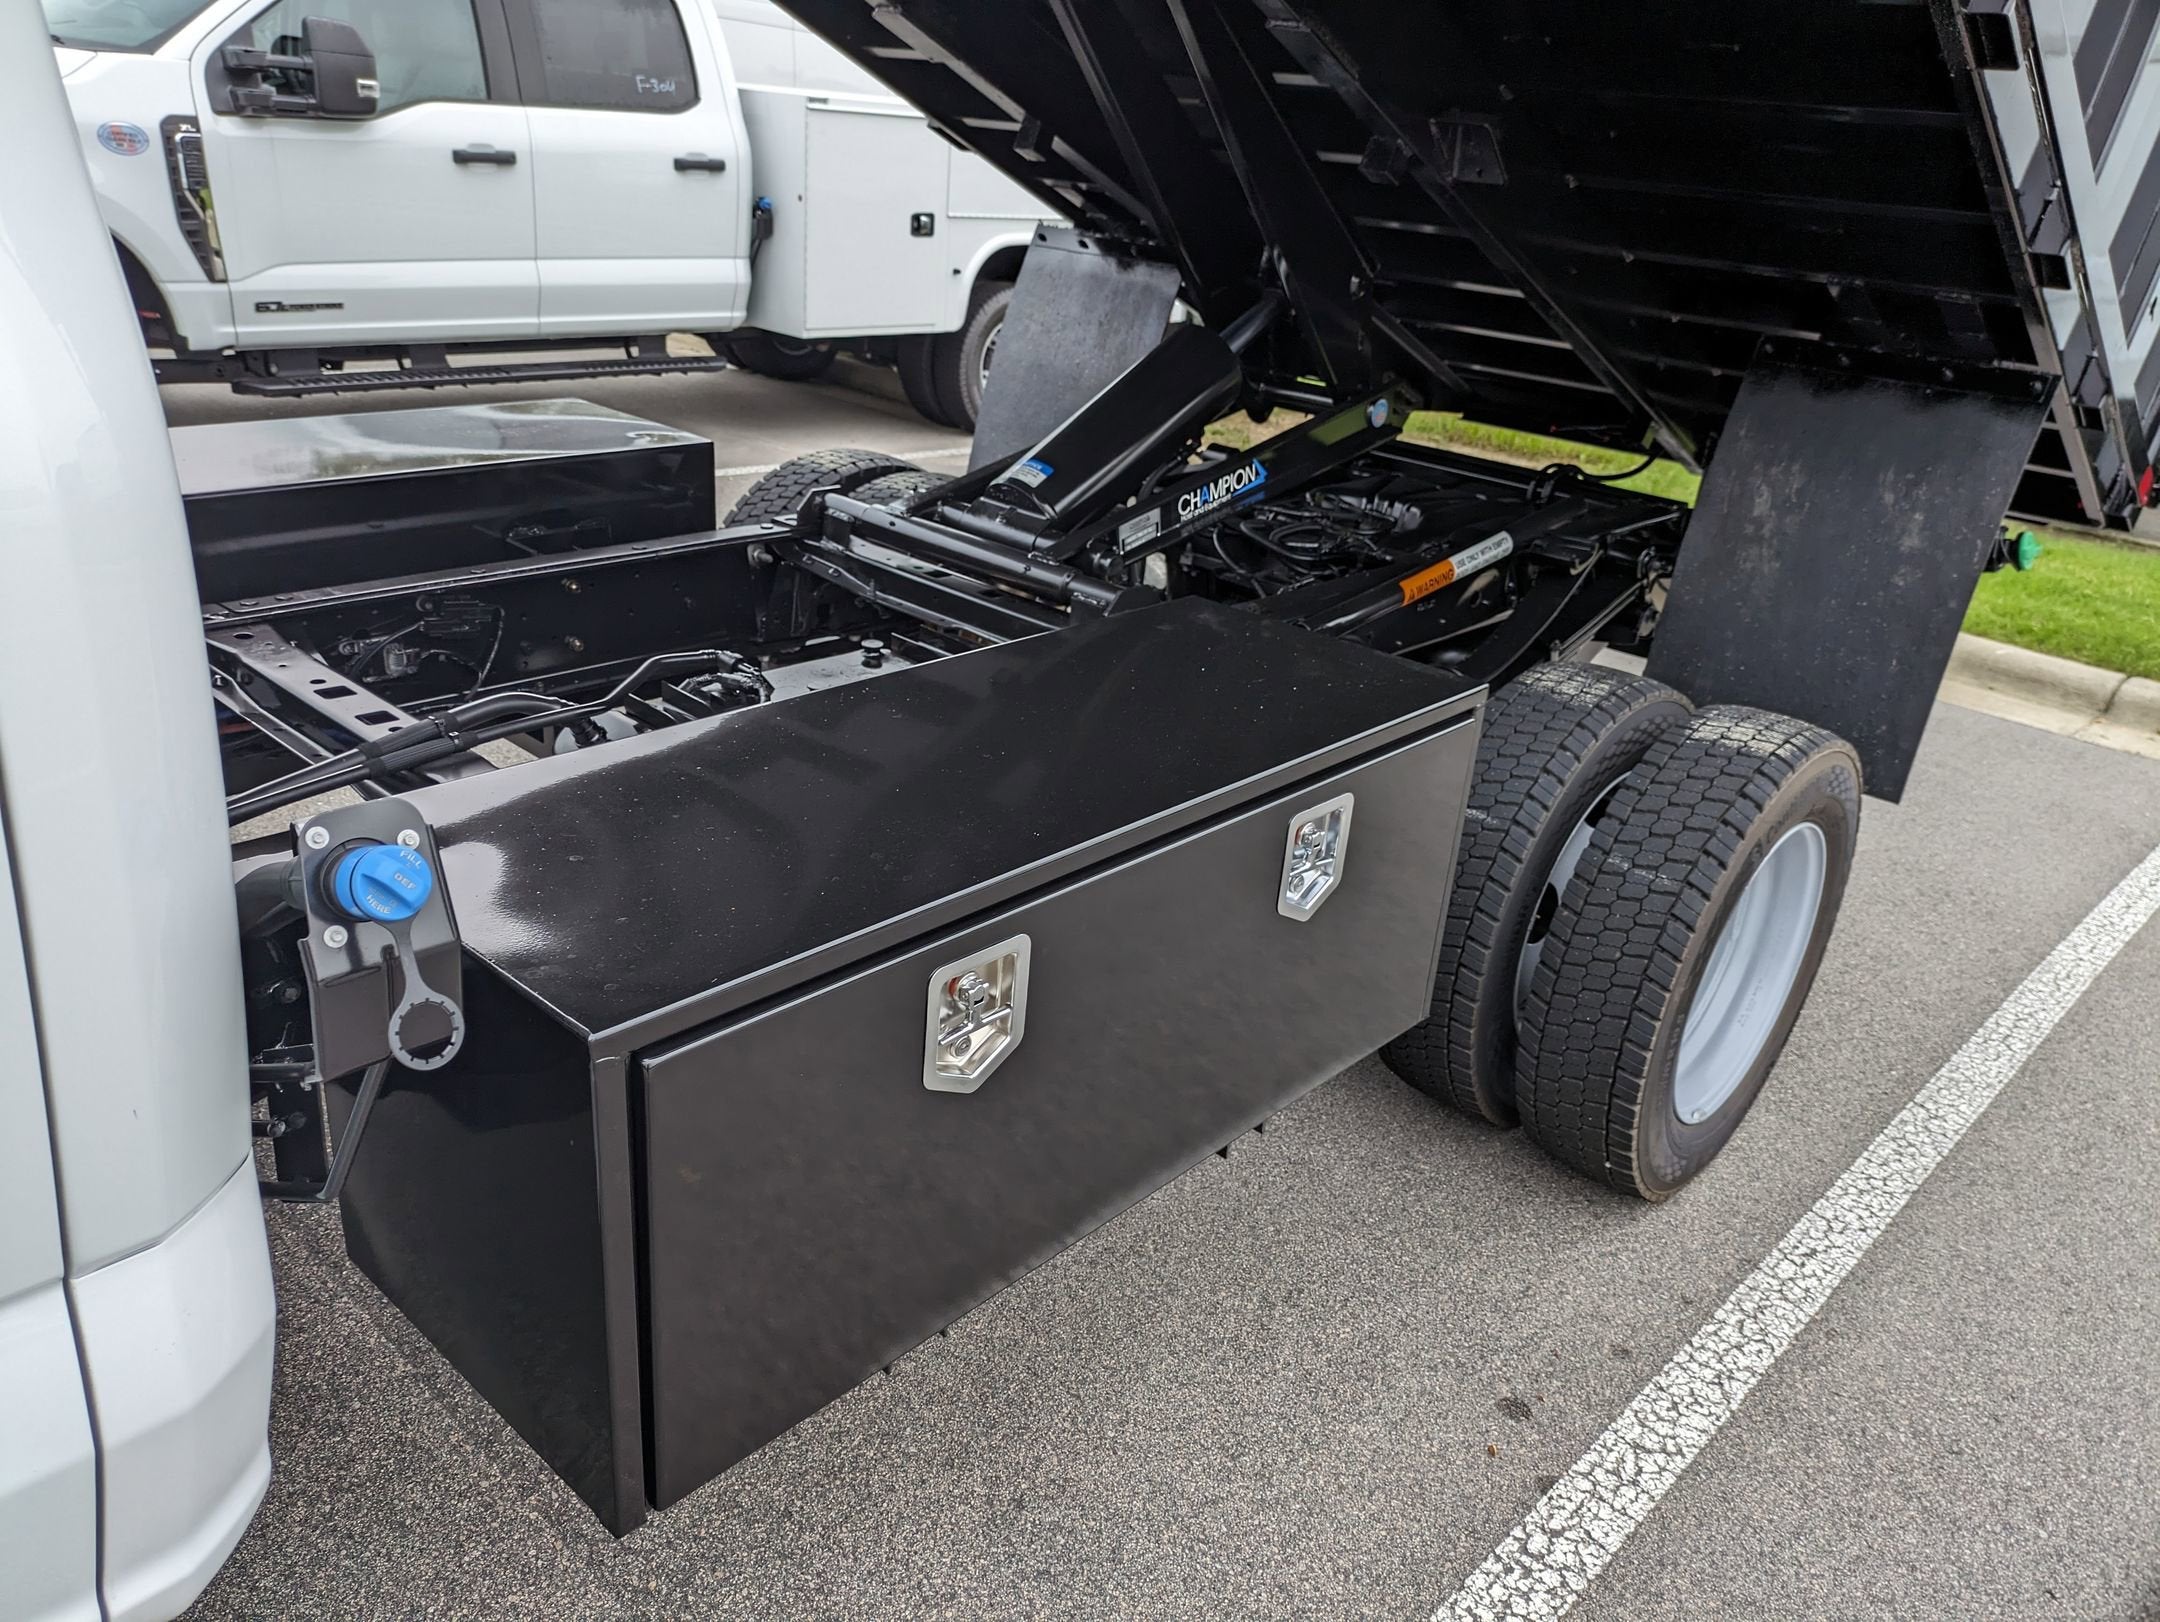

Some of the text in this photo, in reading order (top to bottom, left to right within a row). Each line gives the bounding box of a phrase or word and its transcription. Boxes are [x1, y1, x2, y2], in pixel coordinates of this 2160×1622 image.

[1178, 463, 1256, 516] CHAMPION
[1415, 568, 1455, 598] WARNING
[400, 850, 421, 868] FILL
[366, 894, 391, 914] HERE
